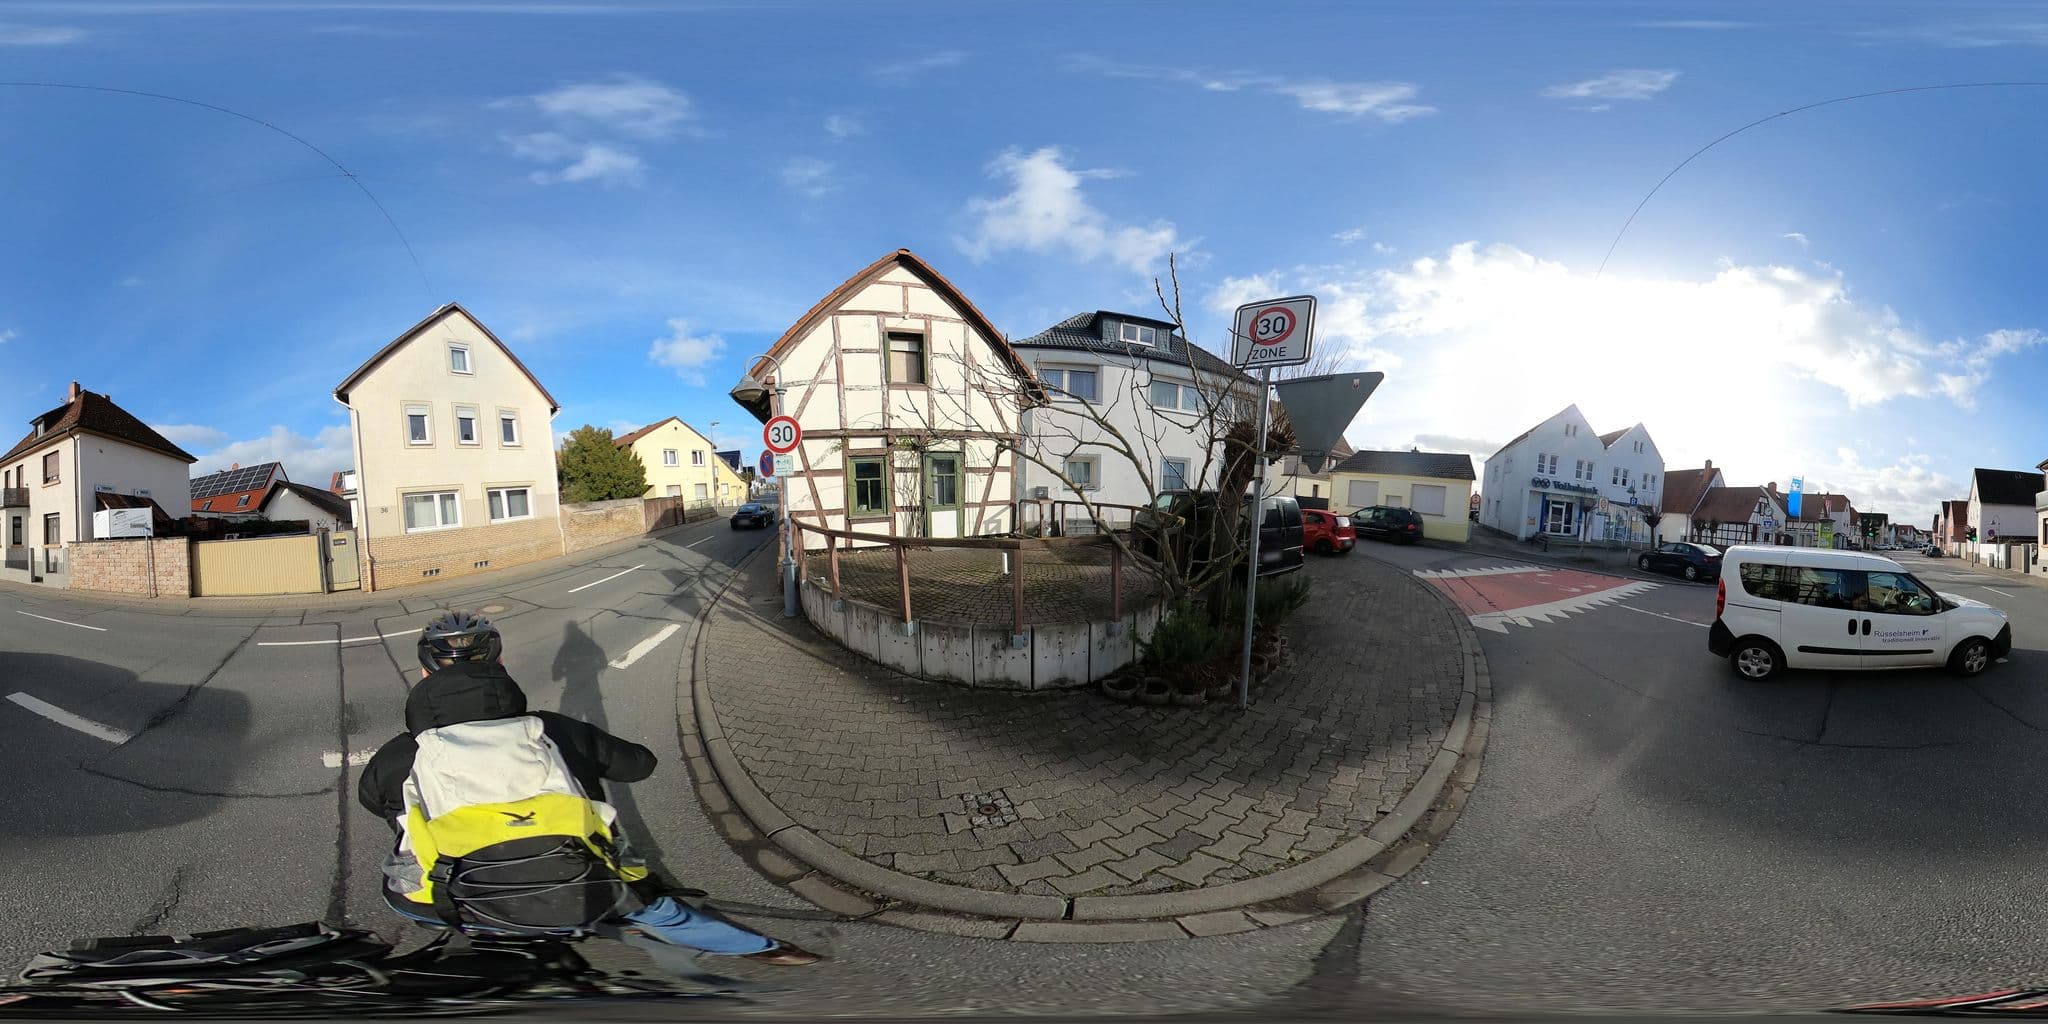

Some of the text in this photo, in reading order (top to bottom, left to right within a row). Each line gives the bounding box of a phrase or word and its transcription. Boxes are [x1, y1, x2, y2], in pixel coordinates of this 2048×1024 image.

[1258, 316, 1286, 336] 30
[1252, 346, 1287, 360] ZONE
[771, 425, 793, 443] 30
[1873, 629, 1920, 637] Rüsselsheim
